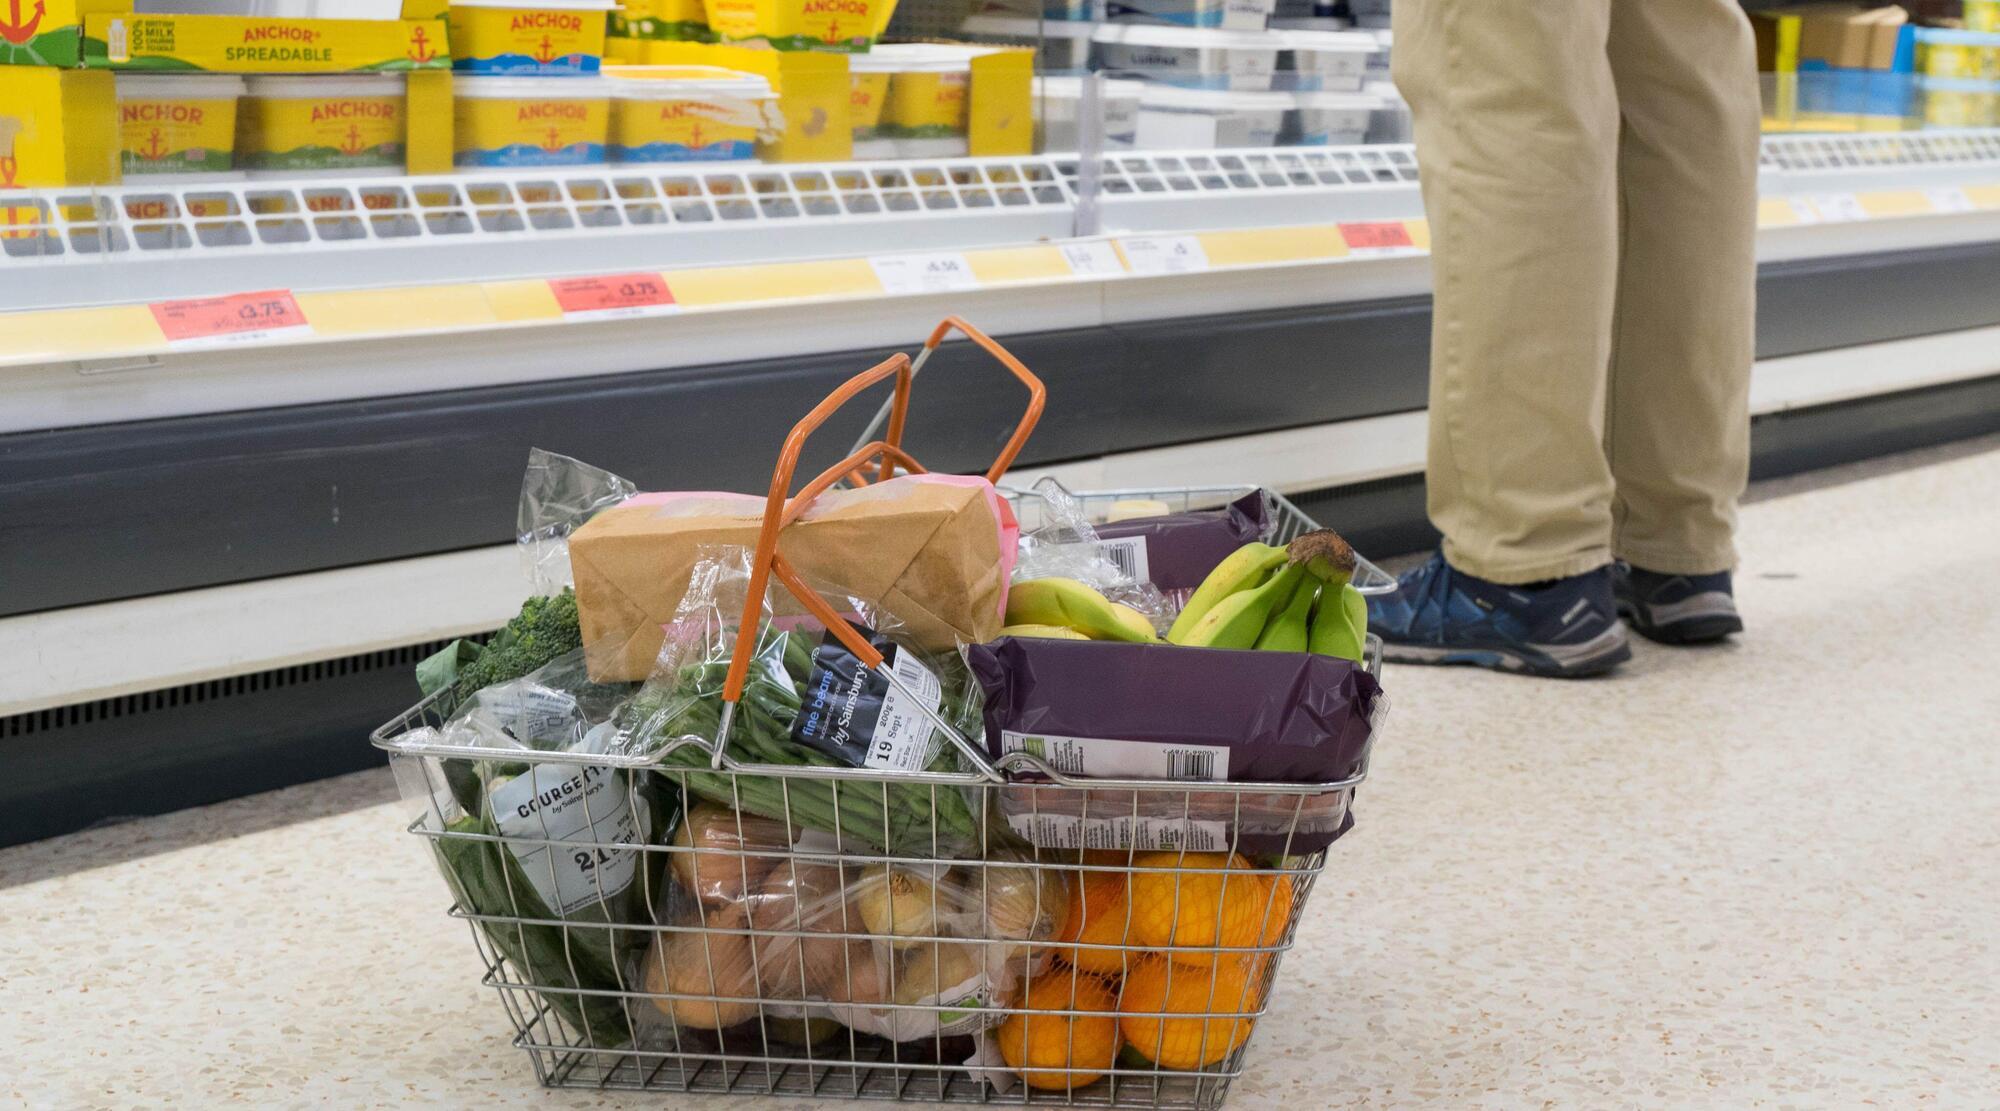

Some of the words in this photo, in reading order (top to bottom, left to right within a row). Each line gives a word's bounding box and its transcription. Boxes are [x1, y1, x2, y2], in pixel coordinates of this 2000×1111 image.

[145, 28, 175, 37] MILK
[511, 13, 582, 32] ANCHOR
[226, 47, 332, 62] SPREADABLE
[122, 104, 203, 125] NCHOR
[311, 102, 394, 123] ANCHOR
[518, 104, 587, 121] ANCHOR
[238, 301, 285, 319] £3.75
[802, 711, 819, 737] fine
[811, 670, 833, 709] beans
[837, 660, 869, 728] Sainsbury's
[879, 705, 894, 728] 200g
[831, 727, 850, 747] by
[877, 741, 893, 762] 19
[888, 714, 902, 739] Sept
[517, 766, 608, 818] COURGETT
[552, 803, 563, 814] by
[574, 848, 610, 873] 21
[613, 829, 636, 857] Spt
